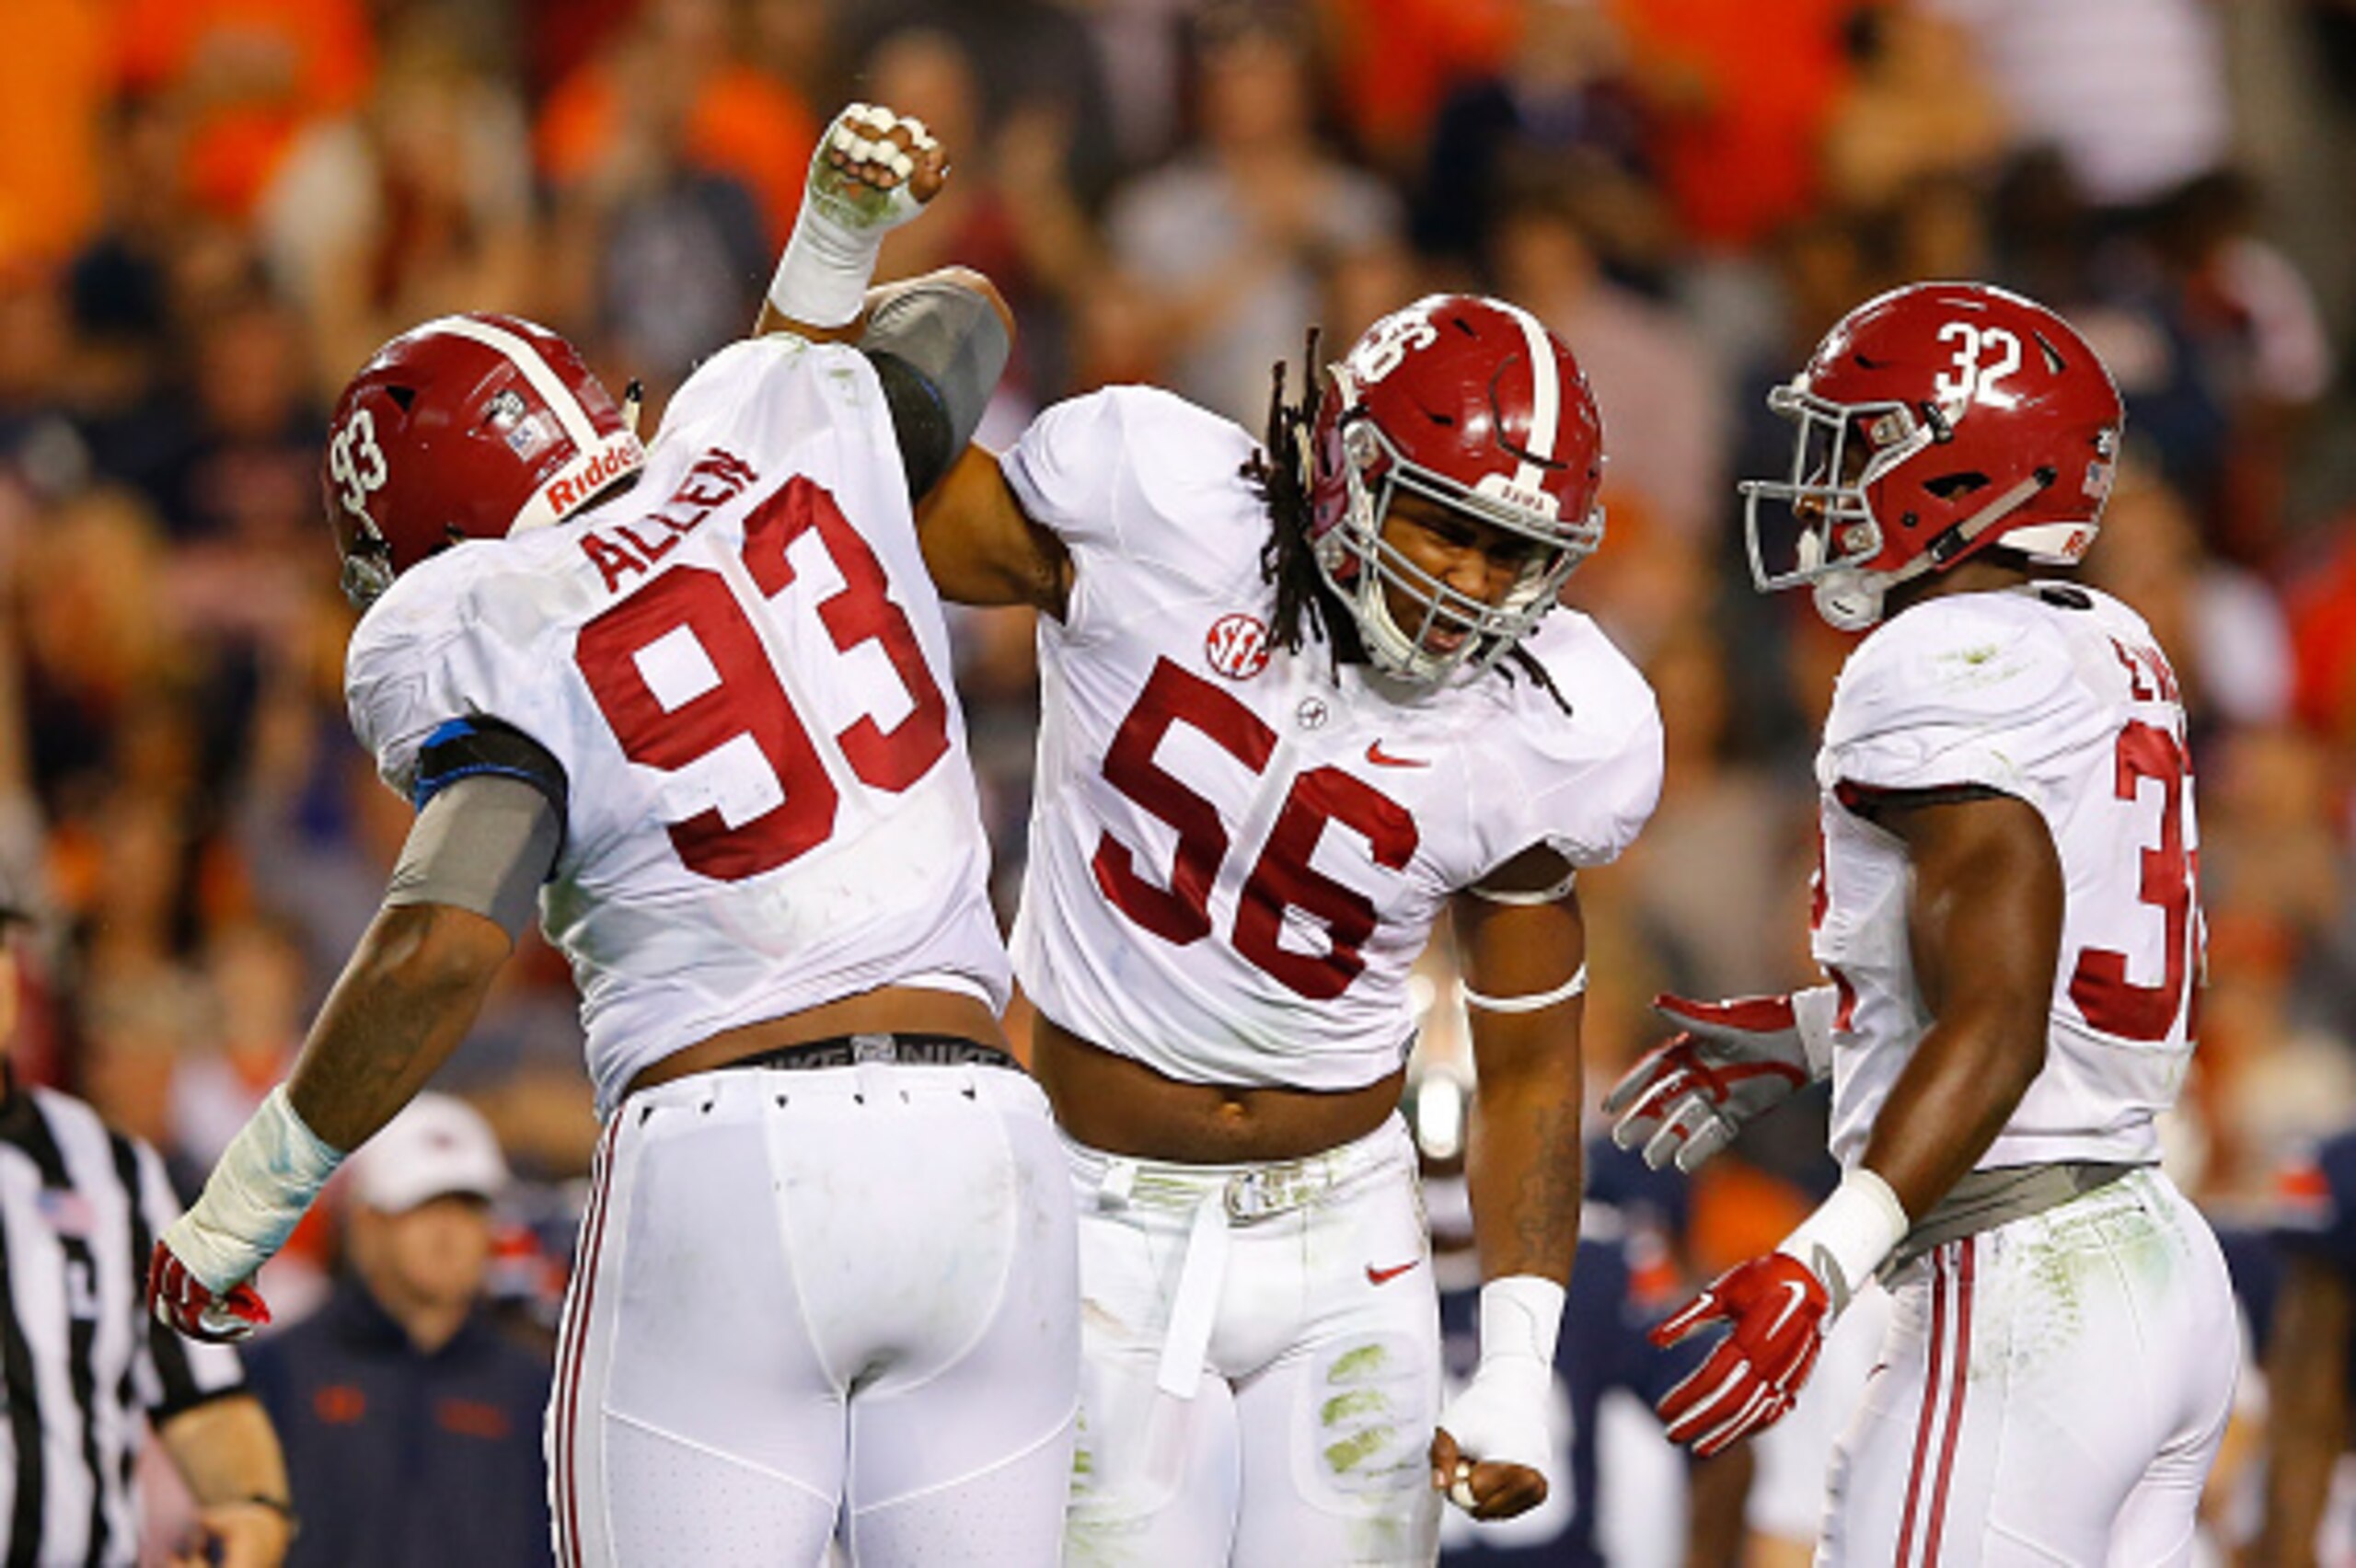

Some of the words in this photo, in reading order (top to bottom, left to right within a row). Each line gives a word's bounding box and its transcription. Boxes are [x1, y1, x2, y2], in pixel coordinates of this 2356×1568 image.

[1934, 321, 2022, 410] 32
[330, 408, 387, 513] 93
[579, 447, 758, 594] ALLEN
[573, 473, 952, 883] 93
[1091, 654, 1419, 1000] 56
[2068, 717, 2201, 1043] 3
[899, 1043, 1001, 1067] NIKE
